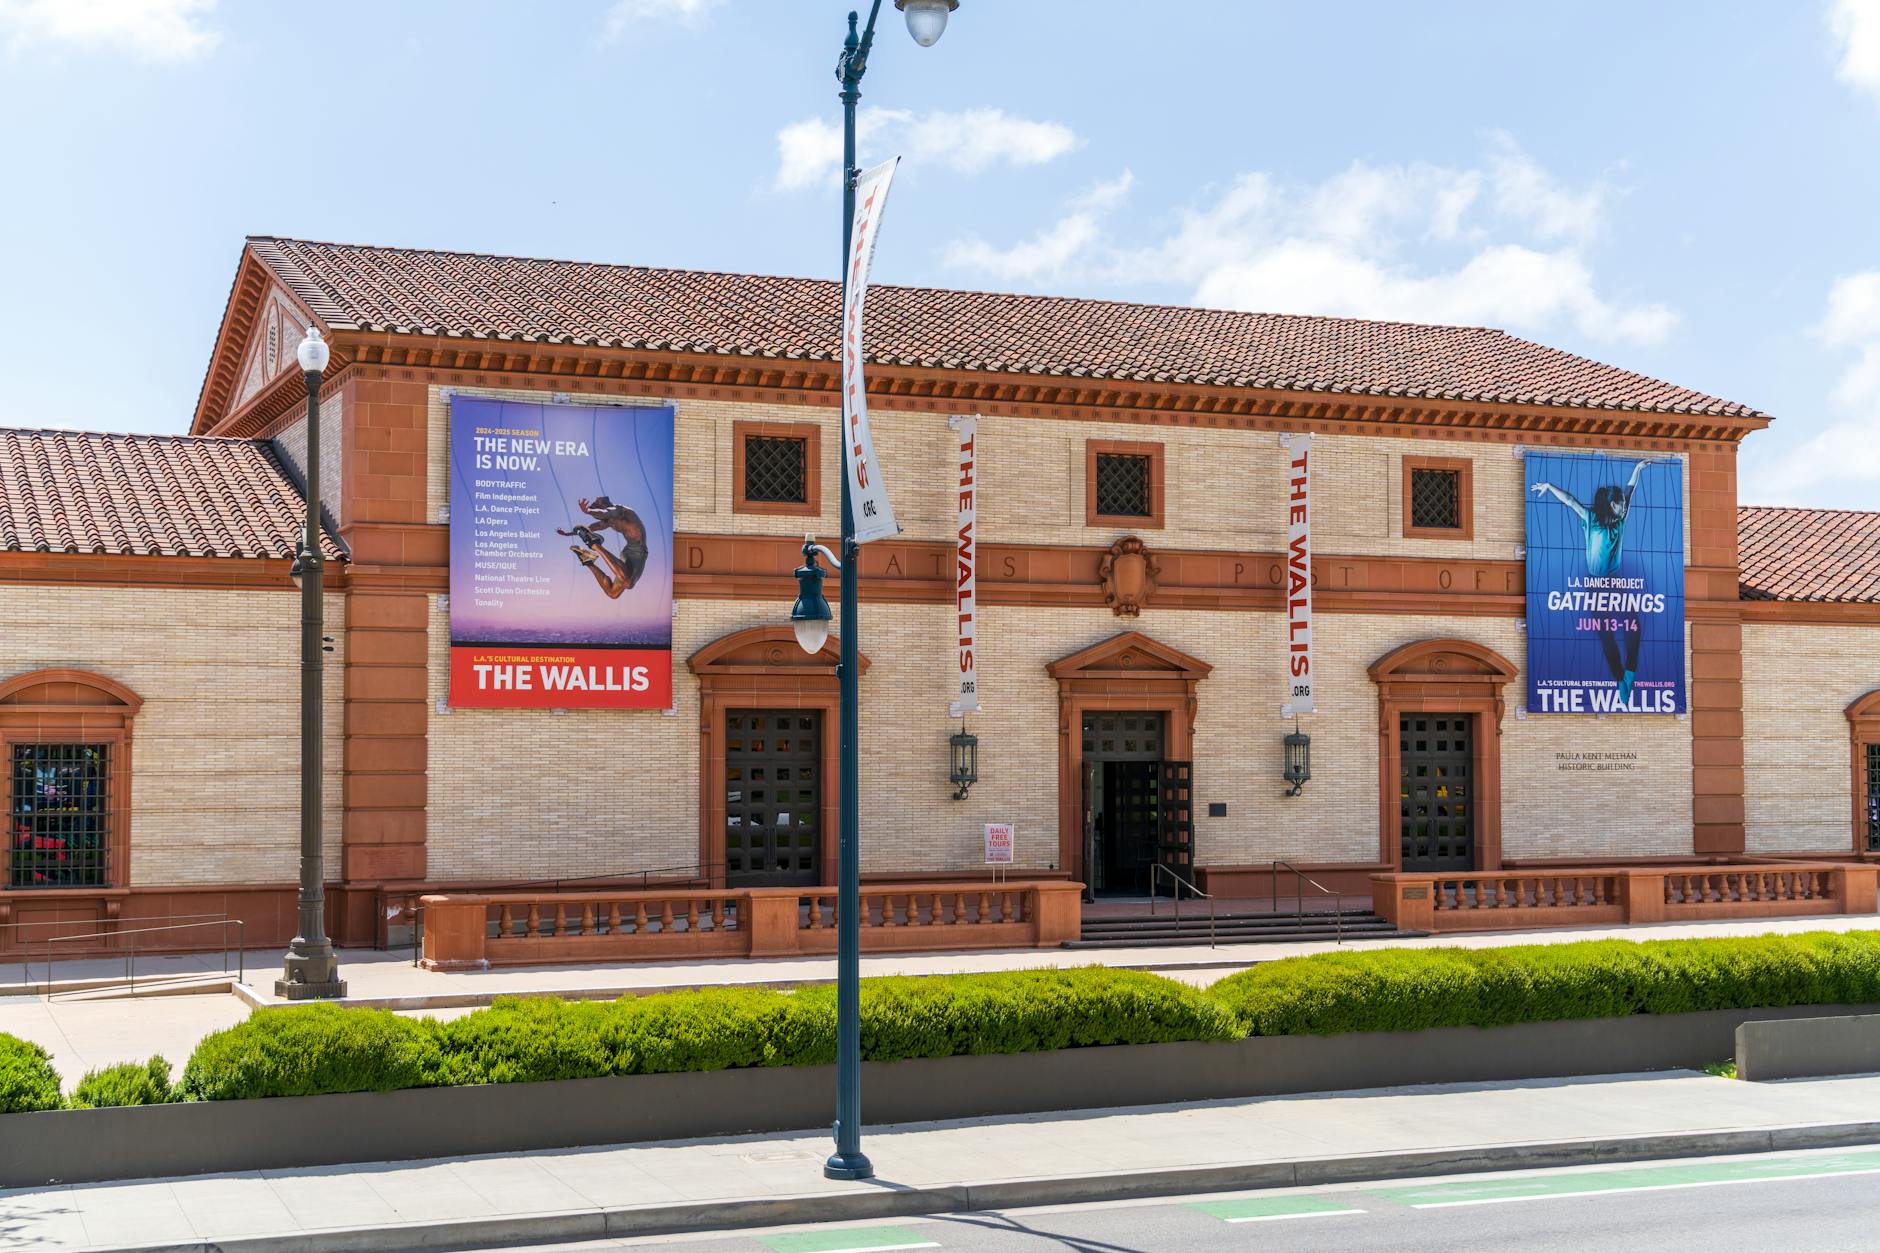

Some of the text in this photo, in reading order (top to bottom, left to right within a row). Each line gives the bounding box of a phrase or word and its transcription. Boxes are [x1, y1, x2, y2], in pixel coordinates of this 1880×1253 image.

[475, 427, 510, 435] 2024-2025
[473, 437, 589, 456] THE NEW ERA
[476, 454, 541, 471] IS NOW.
[475, 480, 527, 489] BODYTRAFFIC
[475, 492, 537, 502] Film Independent
[491, 505, 513, 513] Dance
[514, 506, 540, 515] Project
[475, 517, 508, 526] LA Opera
[475, 529, 541, 539] Los Angeles Ballet
[475, 540, 518, 550] Los Angeles
[475, 549, 544, 559] Chamber Orchestra
[959, 433, 974, 673] THE WALLIS
[475, 561, 518, 570] MUSE/IQUE
[1290, 451, 1309, 677] THE WALLIS
[475, 574, 506, 582] National
[507, 575, 535, 583] Theatre
[1567, 576, 1645, 589] L.A. DANCE PROJECT
[475, 586, 551, 596] Scott Dunn Orchestra
[475, 599, 504, 608] Tonality
[1548, 591, 1665, 613] GATHERINGS
[1575, 618, 1638, 632] JUN 13-14
[494, 655, 529, 663] CULTURAL
[531, 656, 575, 664] DESTINATION
[473, 664, 649, 691] THE WALLIS
[960, 681, 975, 694] .ORG
[1292, 685, 1310, 697] .ORG
[1537, 689, 1676, 712] THE WALLIS
[1556, 752, 1580, 760] PAULA
[1604, 752, 1637, 760] MEEHAN
[1558, 763, 1635, 771] HISTORIC BUILDING
